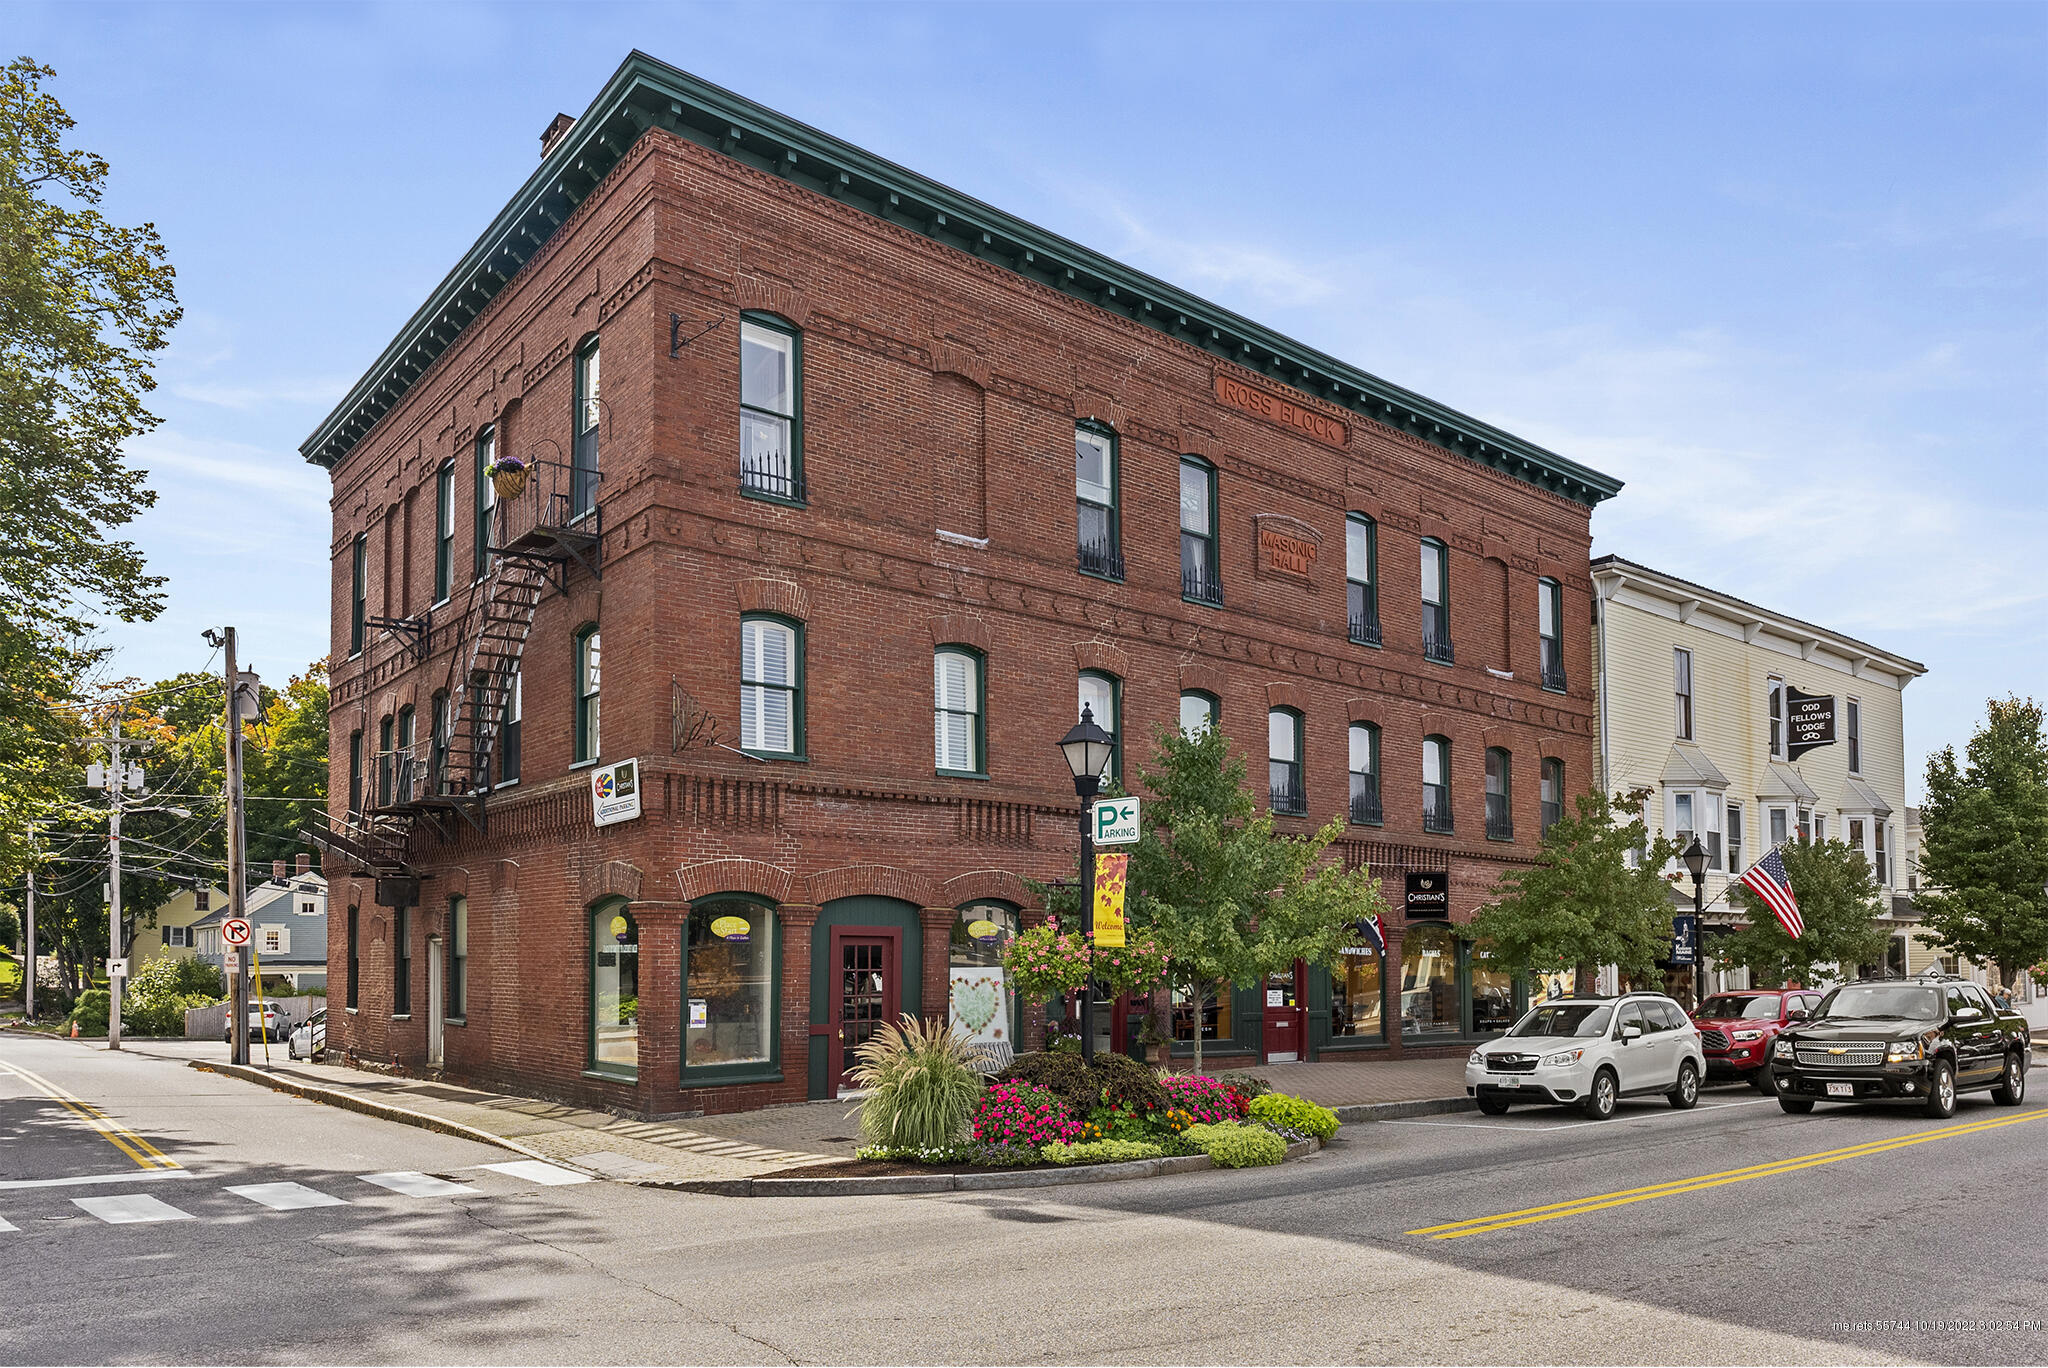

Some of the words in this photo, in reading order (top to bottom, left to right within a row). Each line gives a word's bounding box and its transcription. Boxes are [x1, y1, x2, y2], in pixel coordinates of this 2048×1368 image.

[1225, 381, 1272, 416] ROSS
[1281, 403, 1336, 440] BLOCK
[1261, 531, 1315, 559] MASONIC
[1272, 551, 1306, 574] HALL
[1802, 703, 1820, 711] ODD
[1791, 712, 1831, 722] FELLOWS
[1796, 722, 1825, 731] LODGE
[1408, 893, 1445, 902] CHRISTIAN'S
[1096, 920, 1122, 930] Welcome
